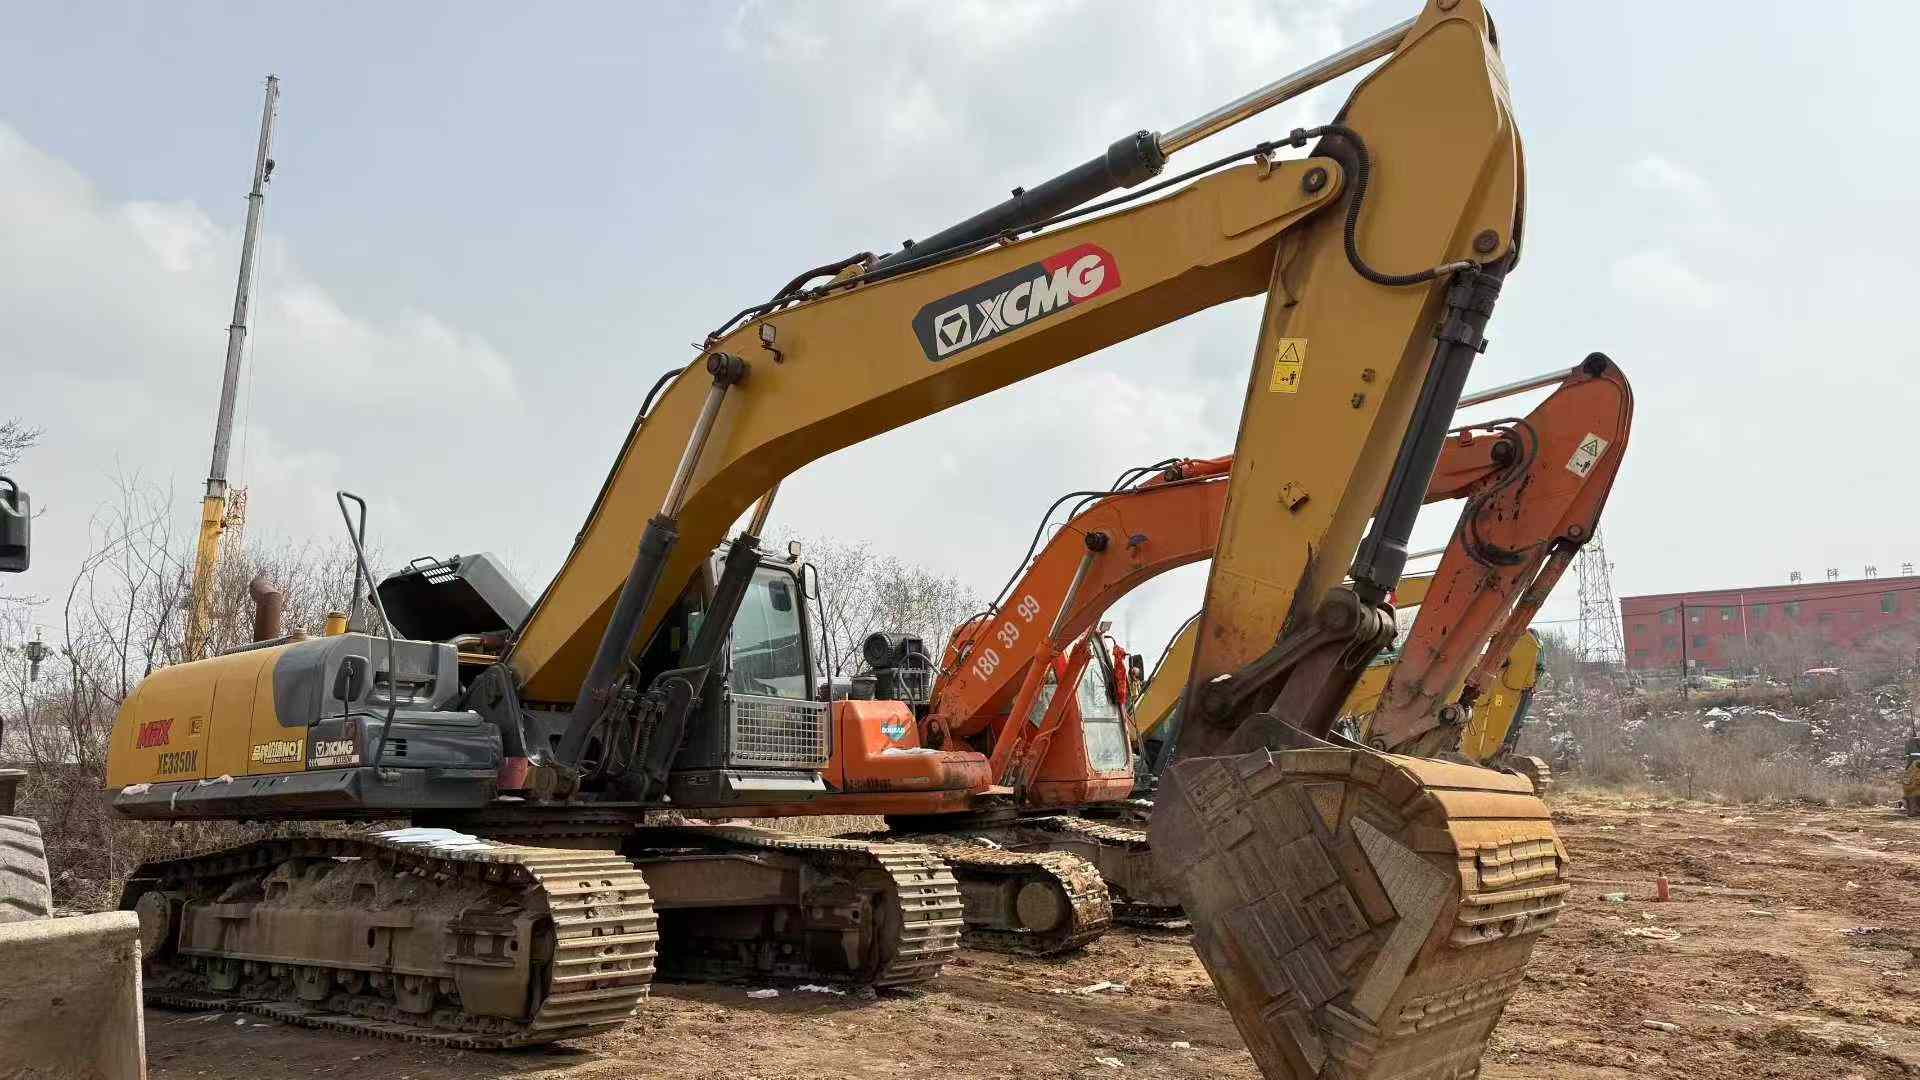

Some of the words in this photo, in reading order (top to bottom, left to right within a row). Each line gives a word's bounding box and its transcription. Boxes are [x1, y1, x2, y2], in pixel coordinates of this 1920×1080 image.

[972, 255, 1105, 343] XCMG
[972, 648, 1000, 682] 180
[997, 622, 1020, 649] 39
[1018, 594, 1040, 622] 99
[157, 750, 198, 775] XE335DK
[325, 740, 353, 756] XCMG
